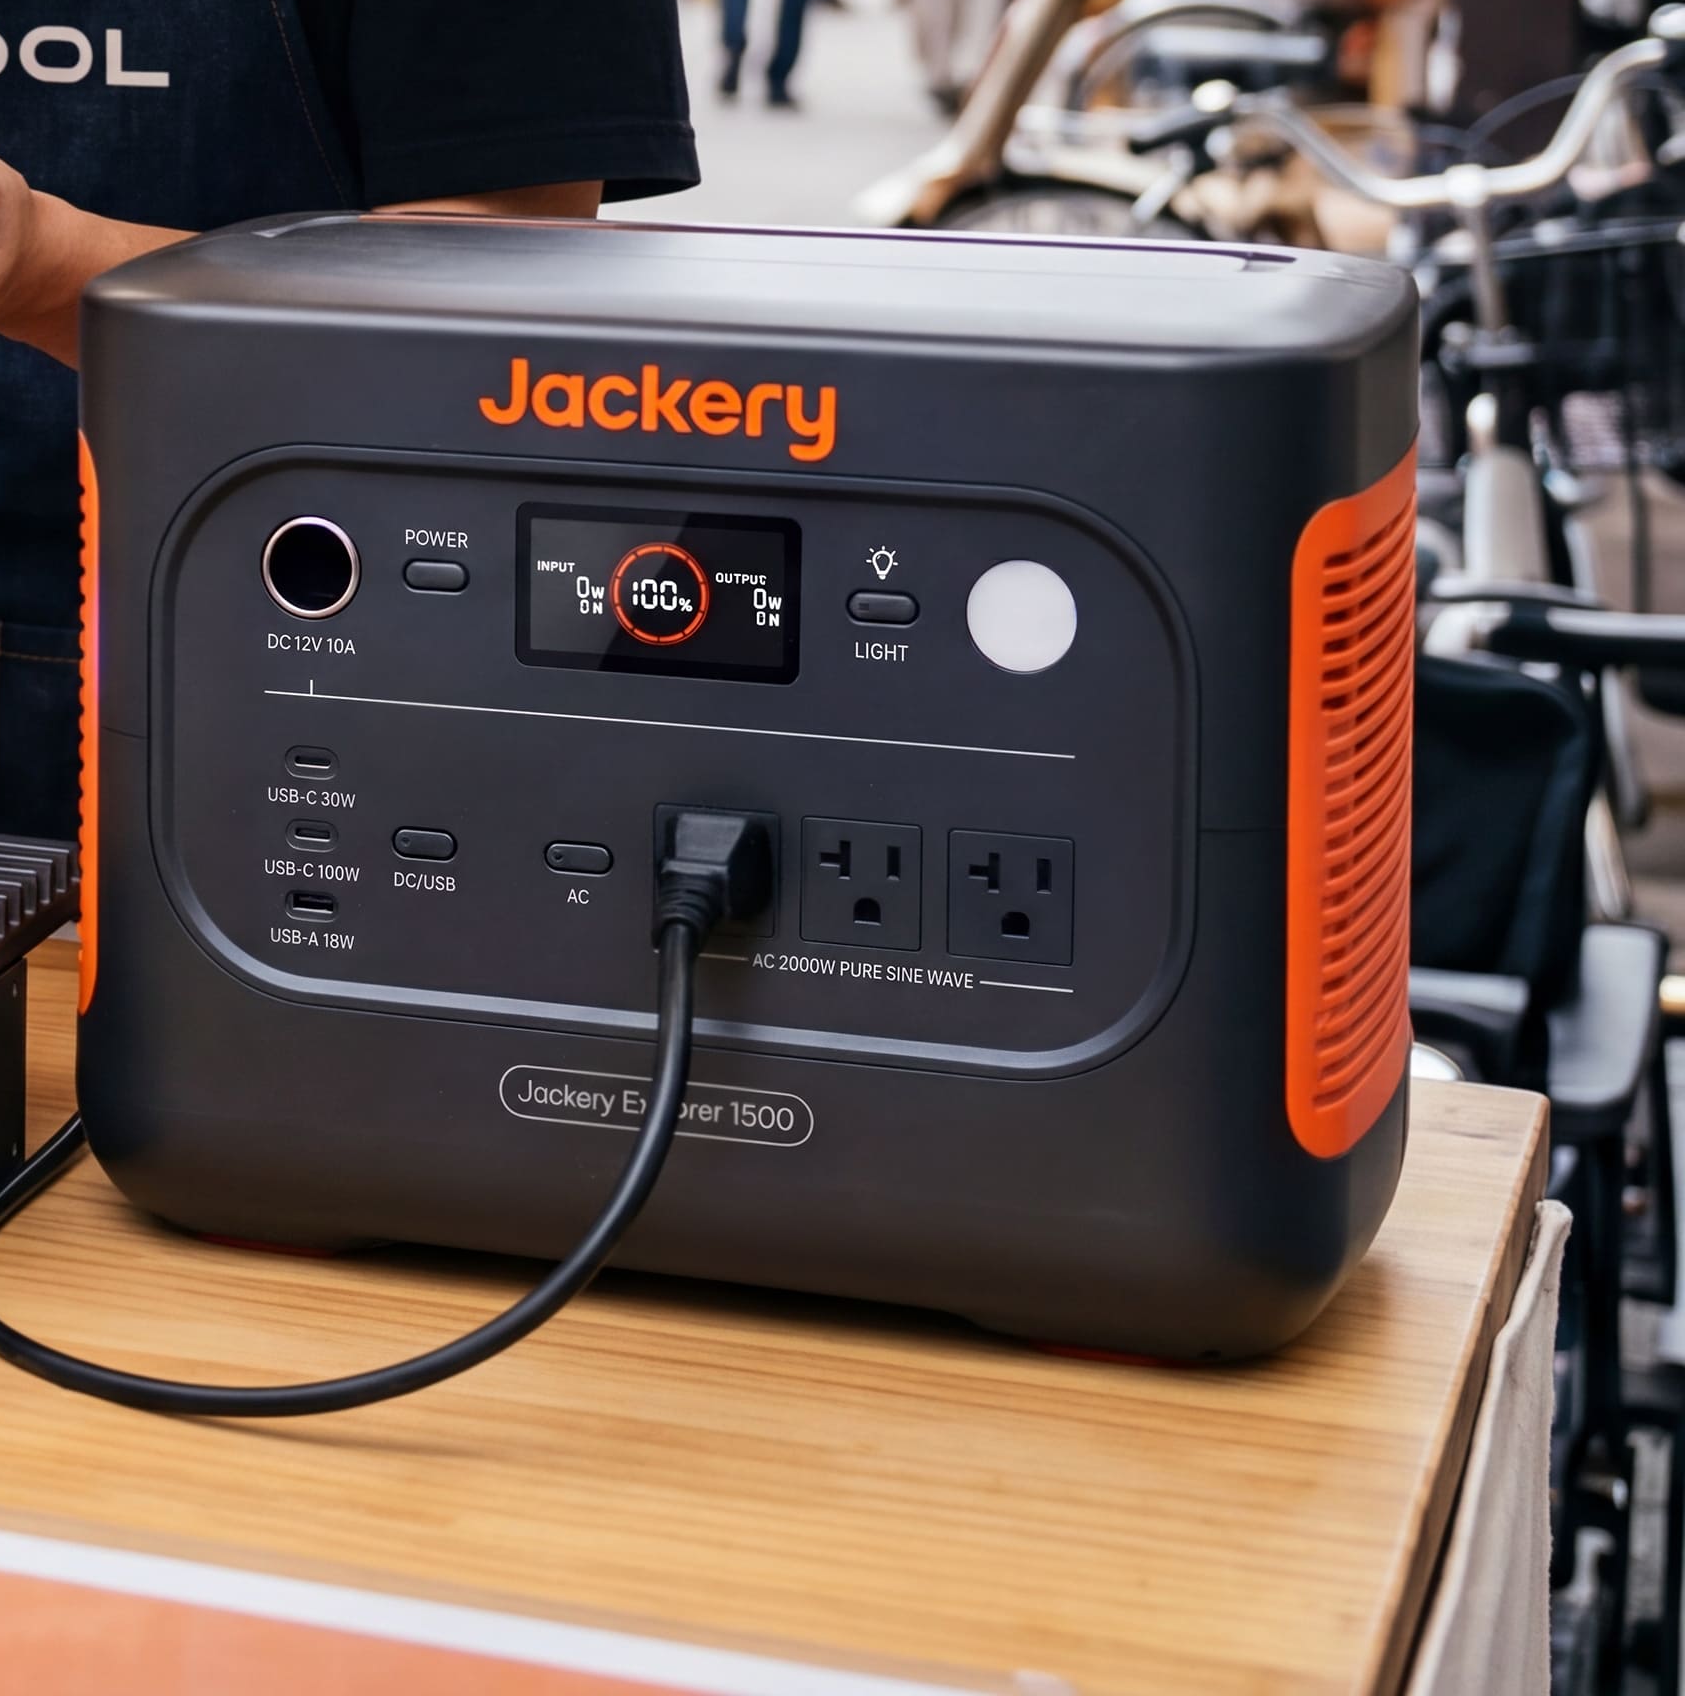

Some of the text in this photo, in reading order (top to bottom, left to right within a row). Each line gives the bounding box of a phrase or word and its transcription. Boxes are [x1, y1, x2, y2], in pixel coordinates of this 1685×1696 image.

[478, 357, 838, 462] Jackery
[405, 528, 469, 549] POWER
[537, 560, 576, 573] INPUT
[632, 578, 694, 612] 100%
[267, 633, 356, 655] DC 12V 10A
[855, 641, 909, 662] LIGHT
[268, 786, 357, 809] USB-C 30W
[264, 859, 360, 882] USB-C 100W
[393, 871, 456, 892] DC/USB
[567, 888, 590, 905] AC
[270, 927, 355, 950] USB-A 18W
[752, 953, 974, 989] AC 2000W PURE SINE WAVE
[517, 1079, 615, 1117] Jackery
[730, 1101, 795, 1132] 1500
